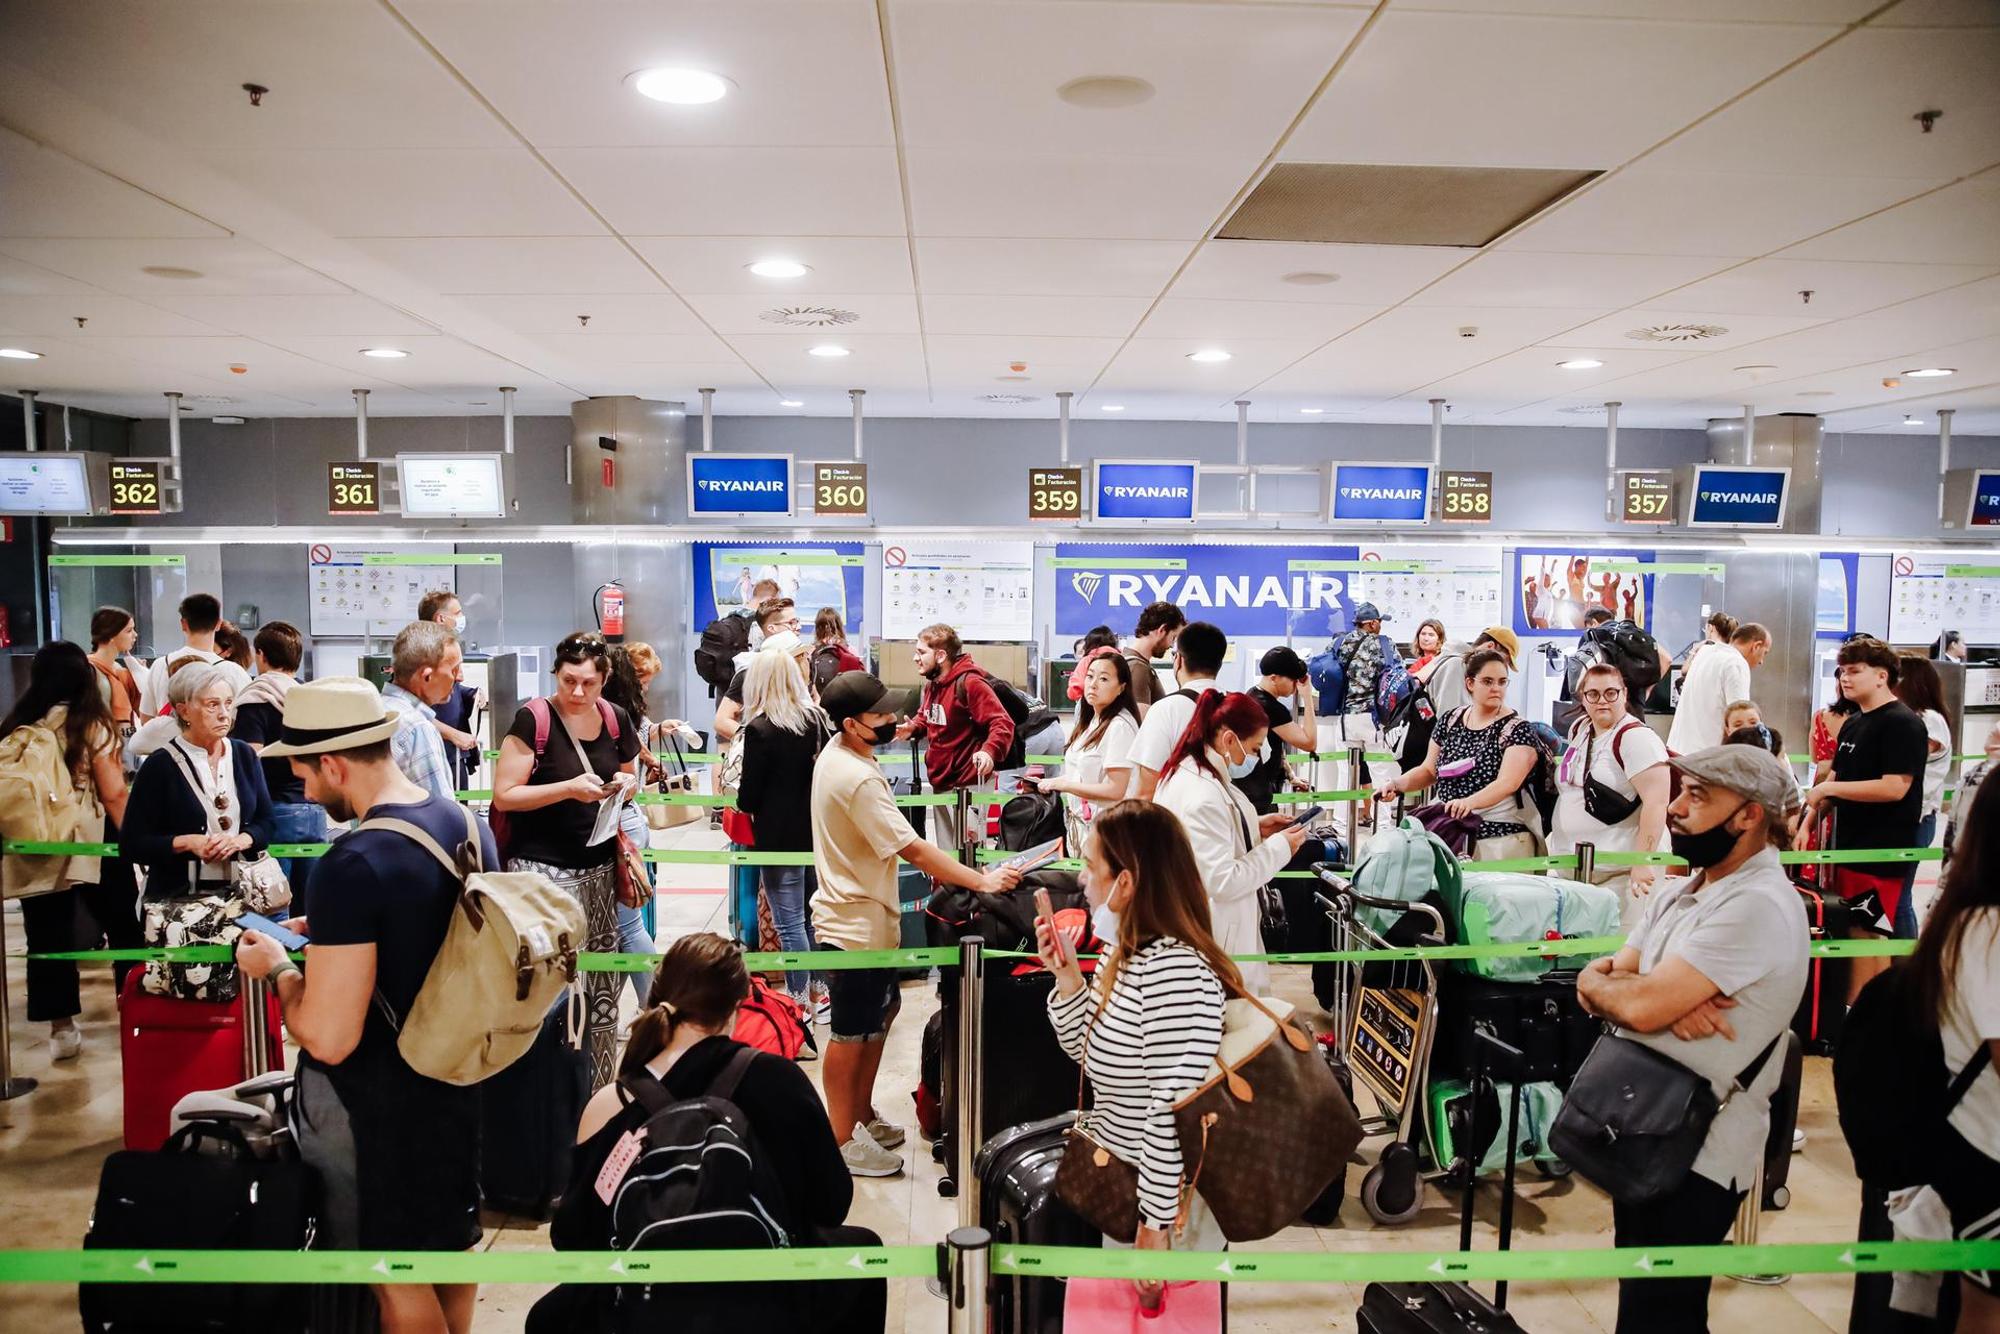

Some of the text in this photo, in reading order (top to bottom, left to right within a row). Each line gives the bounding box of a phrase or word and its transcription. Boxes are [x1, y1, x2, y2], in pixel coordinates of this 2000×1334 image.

[709, 480, 784, 492] RYANAIR
[1114, 486, 1188, 498] RYANAIR
[113, 483, 157, 504] 362
[334, 483, 375, 505] 361
[818, 485, 865, 507] 360
[1351, 488, 1422, 500] RYANAIR
[1710, 492, 1778, 504] RYANAIR
[1033, 490, 1078, 511] 359
[1444, 492, 1489, 513] 358
[1628, 494, 1669, 514] 357
[1108, 574, 1345, 611] RYANAIR
[628, 1262, 651, 1270] aena
[865, 1257, 888, 1266] aena
[1019, 1256, 1041, 1265] aena
[1446, 1262, 1468, 1271] aena
[1235, 1263, 1257, 1271] aena
